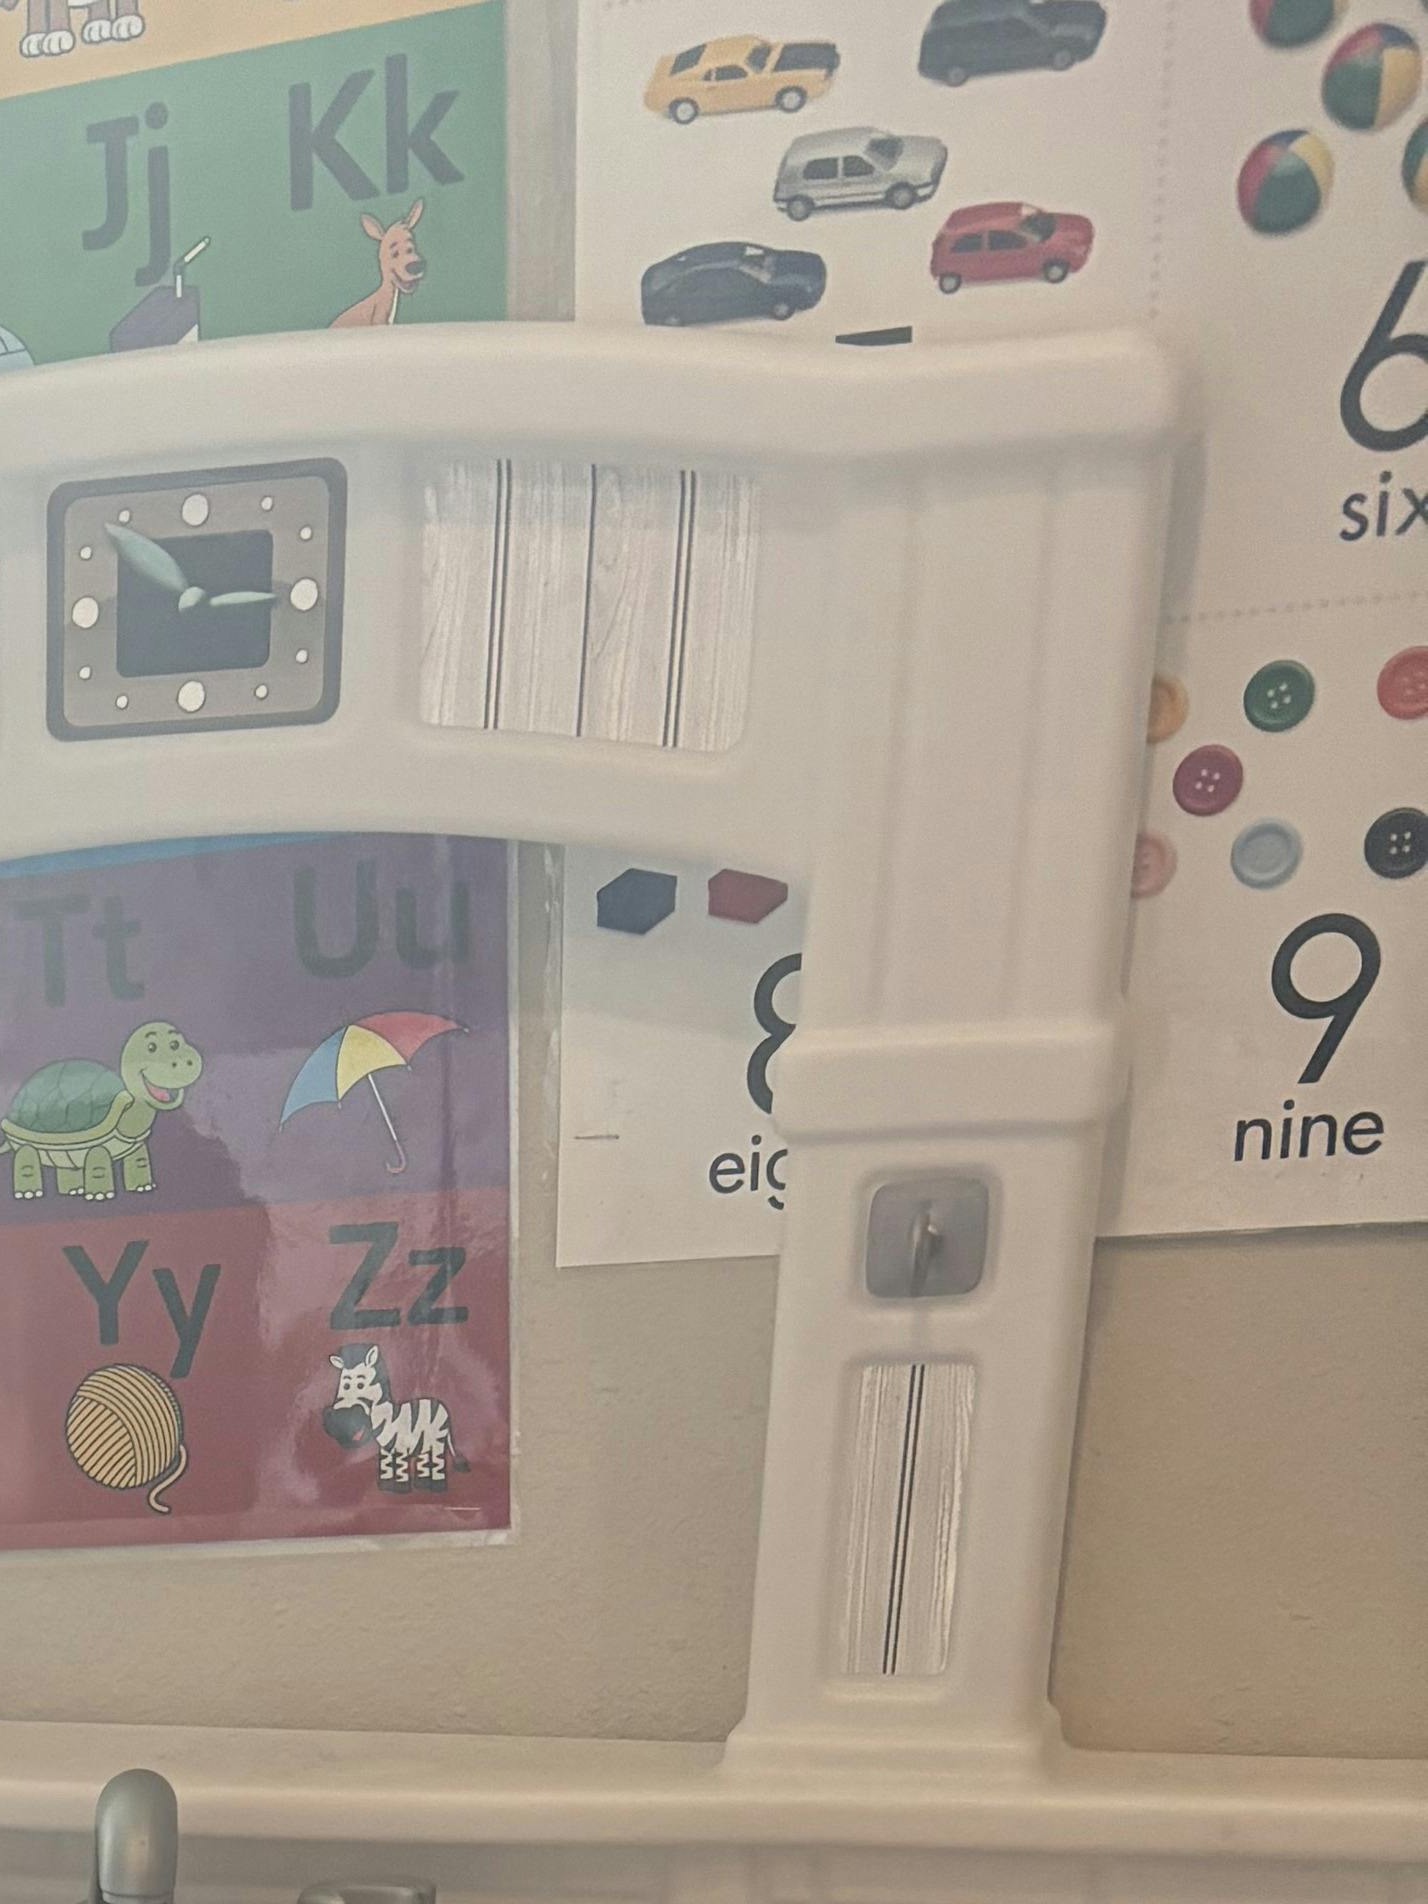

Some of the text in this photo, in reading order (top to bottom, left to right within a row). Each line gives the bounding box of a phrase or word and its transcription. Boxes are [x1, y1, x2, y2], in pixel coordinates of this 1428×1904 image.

[81, 103, 172, 287] Jj
[289, 54, 464, 212] Kk
[1340, 259, 1428, 452] 6
[1339, 470, 1428, 542] six
[20, 892, 146, 1007] Tt
[292, 859, 469, 978] Uu
[1270, 912, 1382, 1084] 9
[1233, 1098, 1385, 1161] nine
[61, 1239, 221, 1378] Yy
[328, 1222, 467, 1331] Zz
